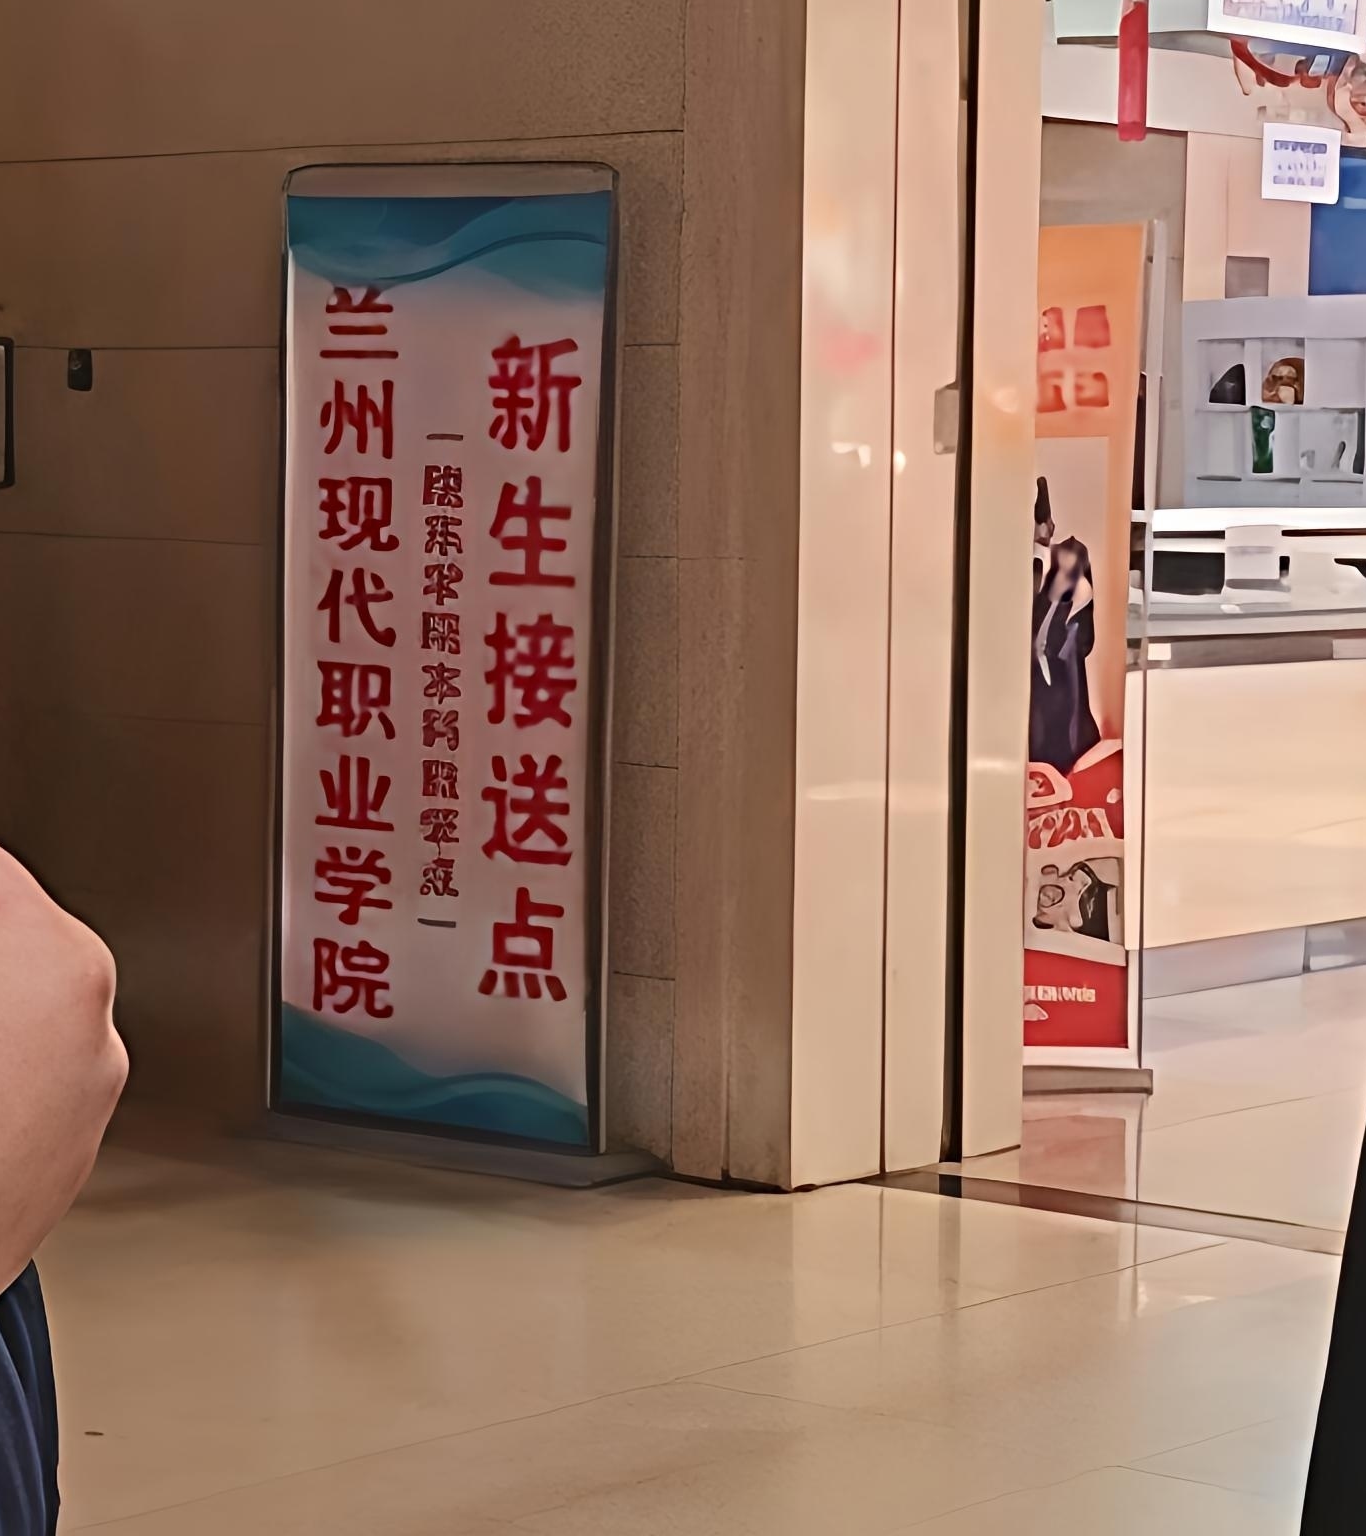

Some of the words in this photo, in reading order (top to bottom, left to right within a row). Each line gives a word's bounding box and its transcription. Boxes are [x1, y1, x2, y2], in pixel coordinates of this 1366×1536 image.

[312, 285, 399, 1020] 兰州现代职业学院
[480, 333, 583, 1004] 新生接送点
